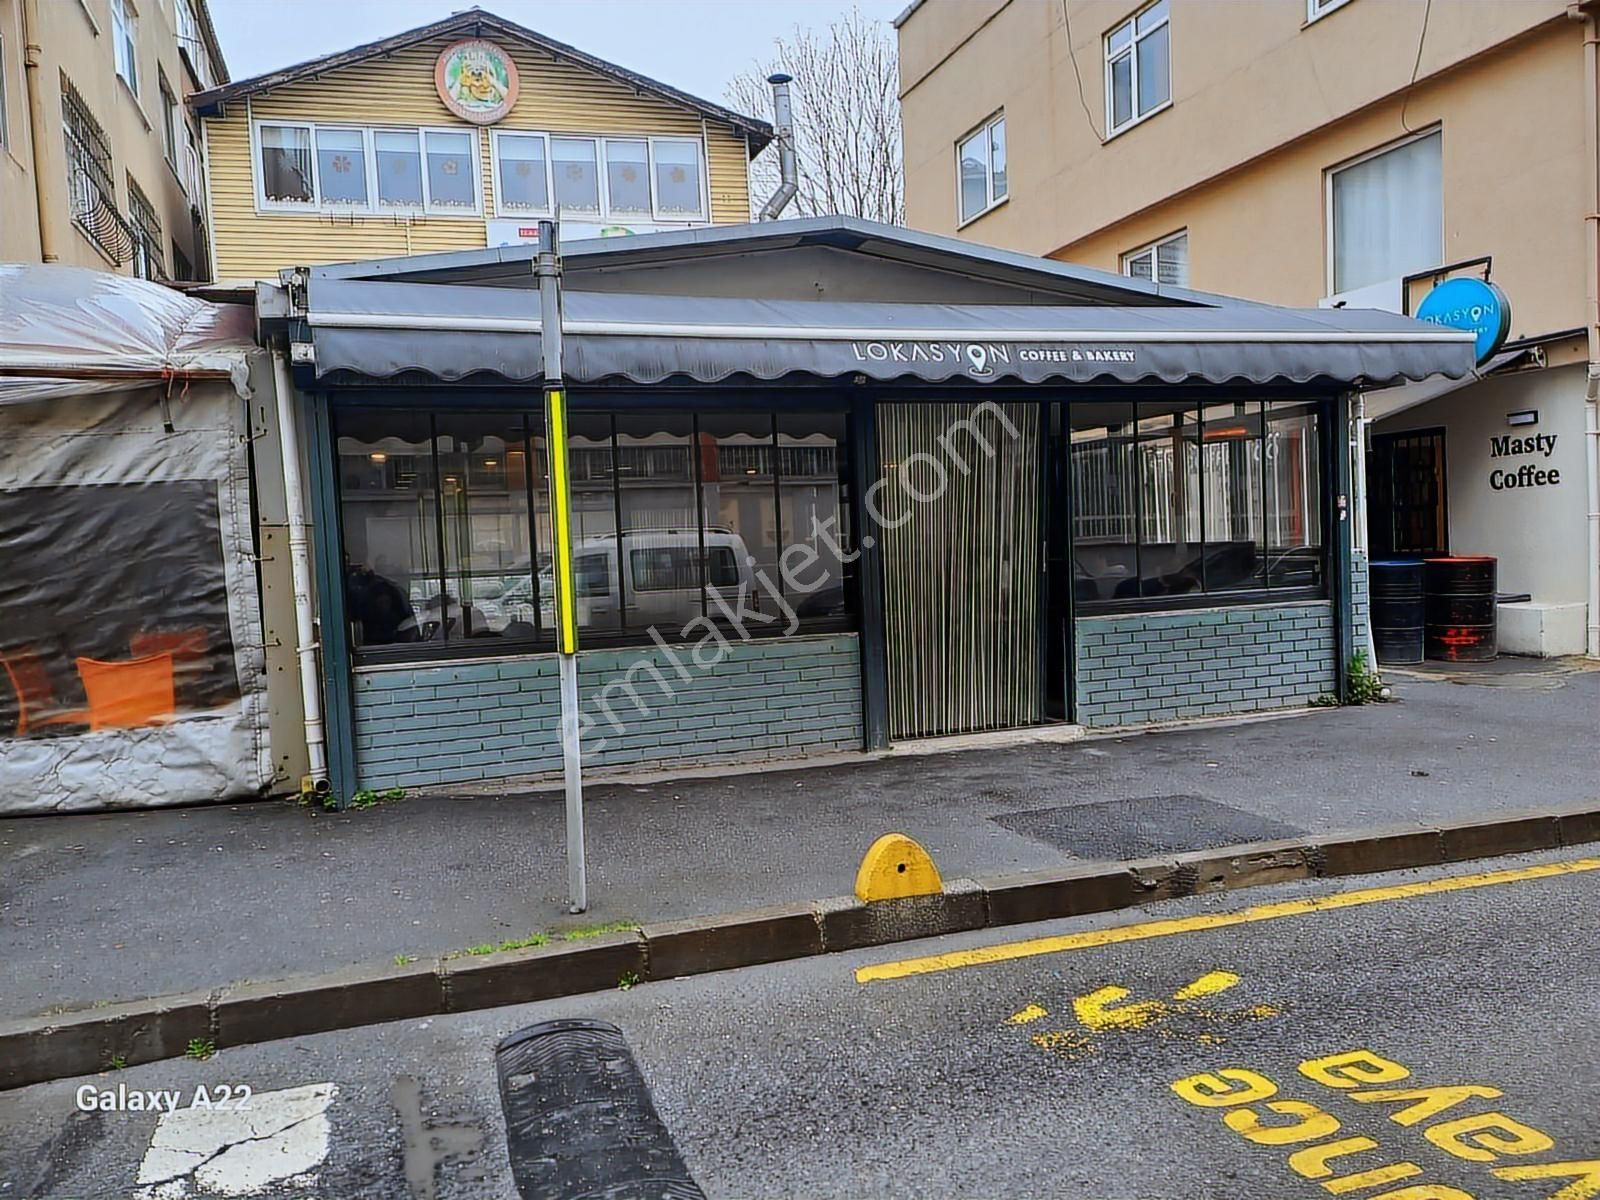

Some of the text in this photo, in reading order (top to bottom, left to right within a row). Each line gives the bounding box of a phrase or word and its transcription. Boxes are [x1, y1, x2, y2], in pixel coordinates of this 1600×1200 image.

[1424, 303, 1494, 326] OKASYON
[851, 342, 1136, 373] LOKASYON COFFEE & BAKERY
[1490, 433, 1558, 457] Masty
[1490, 464, 1560, 491] Coffee
[1170, 1067, 1477, 1200] nce
